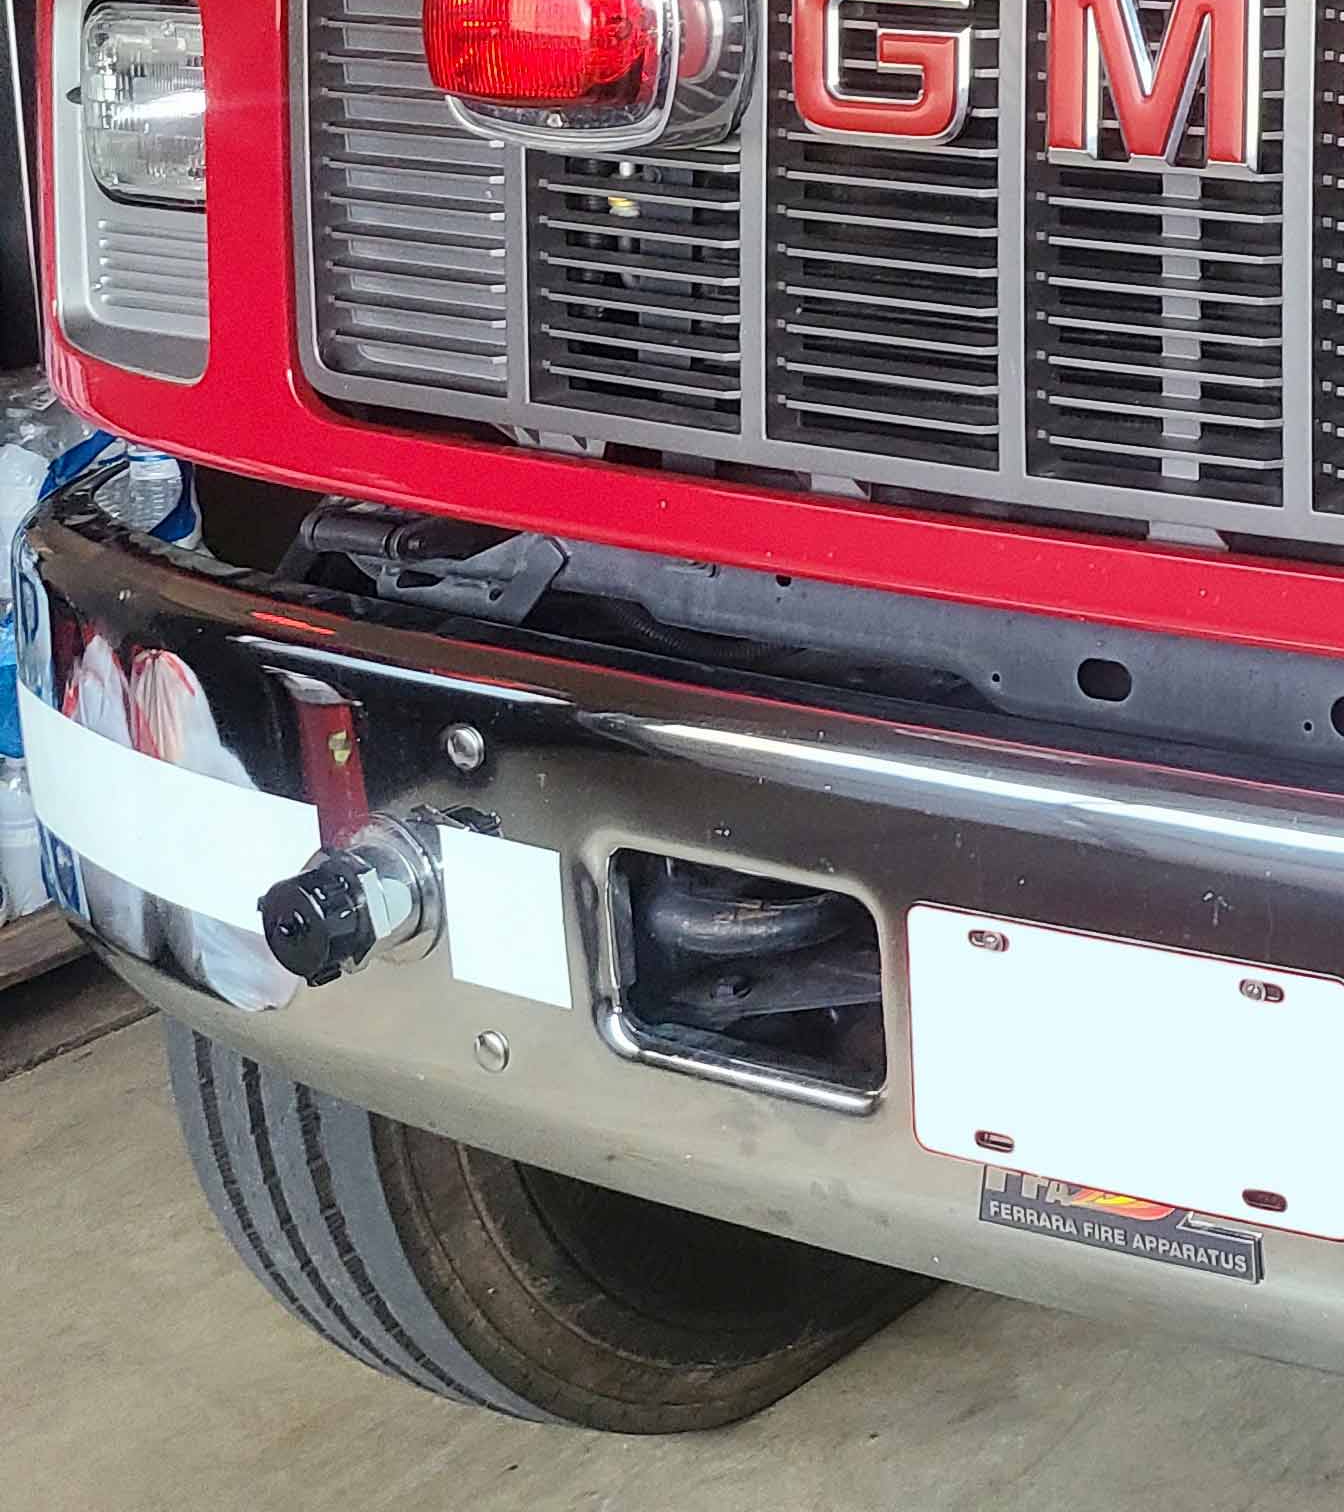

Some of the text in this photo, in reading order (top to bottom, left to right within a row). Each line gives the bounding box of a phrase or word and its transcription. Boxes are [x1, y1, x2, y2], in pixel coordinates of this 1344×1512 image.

[988, 1198, 1248, 1274] FERRARA FIRE APPARATUS
